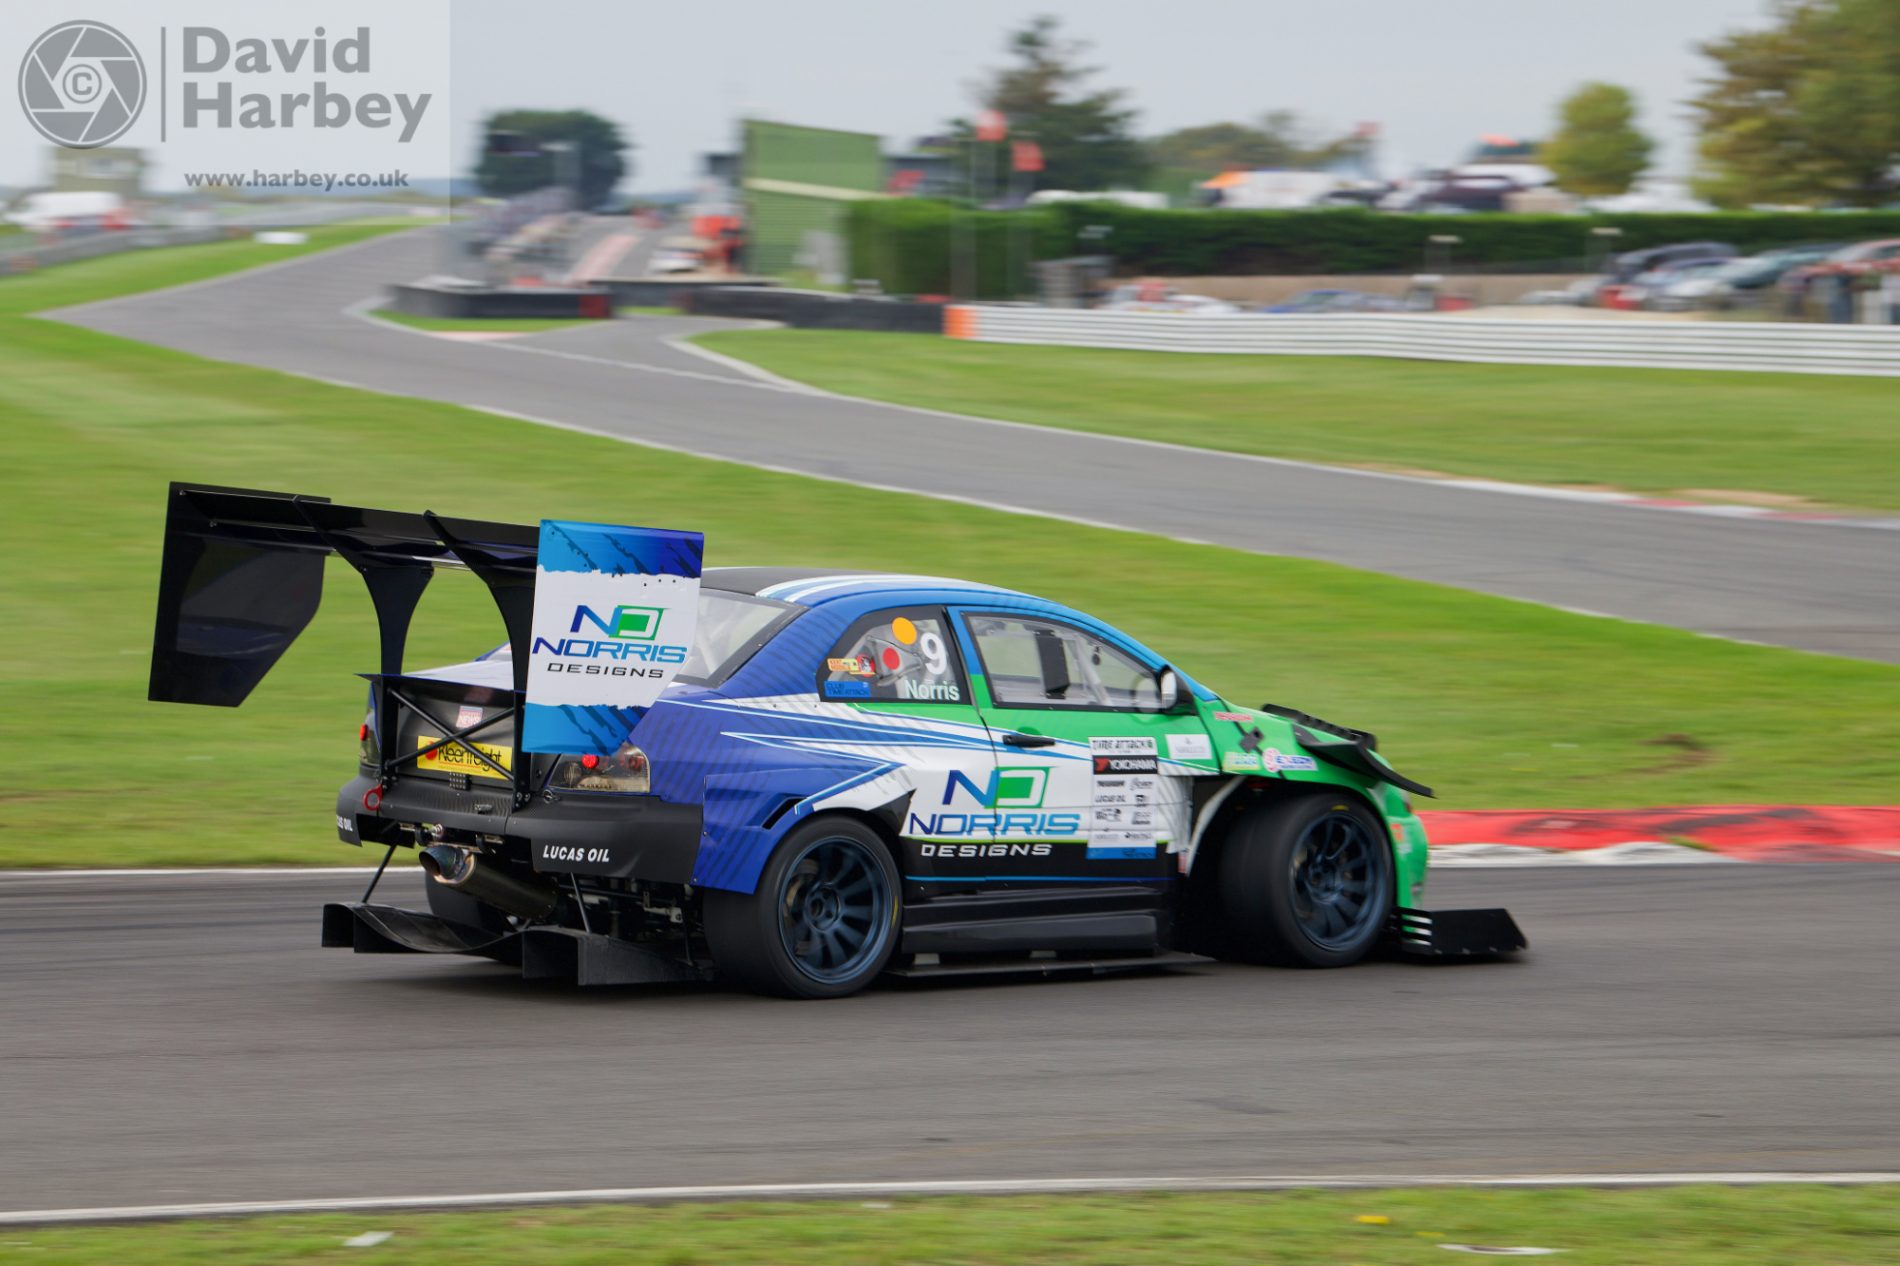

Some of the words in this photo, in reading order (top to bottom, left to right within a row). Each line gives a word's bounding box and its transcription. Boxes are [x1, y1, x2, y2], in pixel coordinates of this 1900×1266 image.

[532, 637, 688, 664] NORRIS
[920, 632, 947, 675] 9
[547, 662, 664, 679] DESIGNS
[904, 679, 960, 701] Norris
[1109, 759, 1158, 770] YOKOHAMA
[909, 812, 1081, 836] NORRIS
[542, 844, 585, 862] LUCAS
[587, 848, 610, 863] OIL
[920, 843, 1052, 858] DESIGNS
